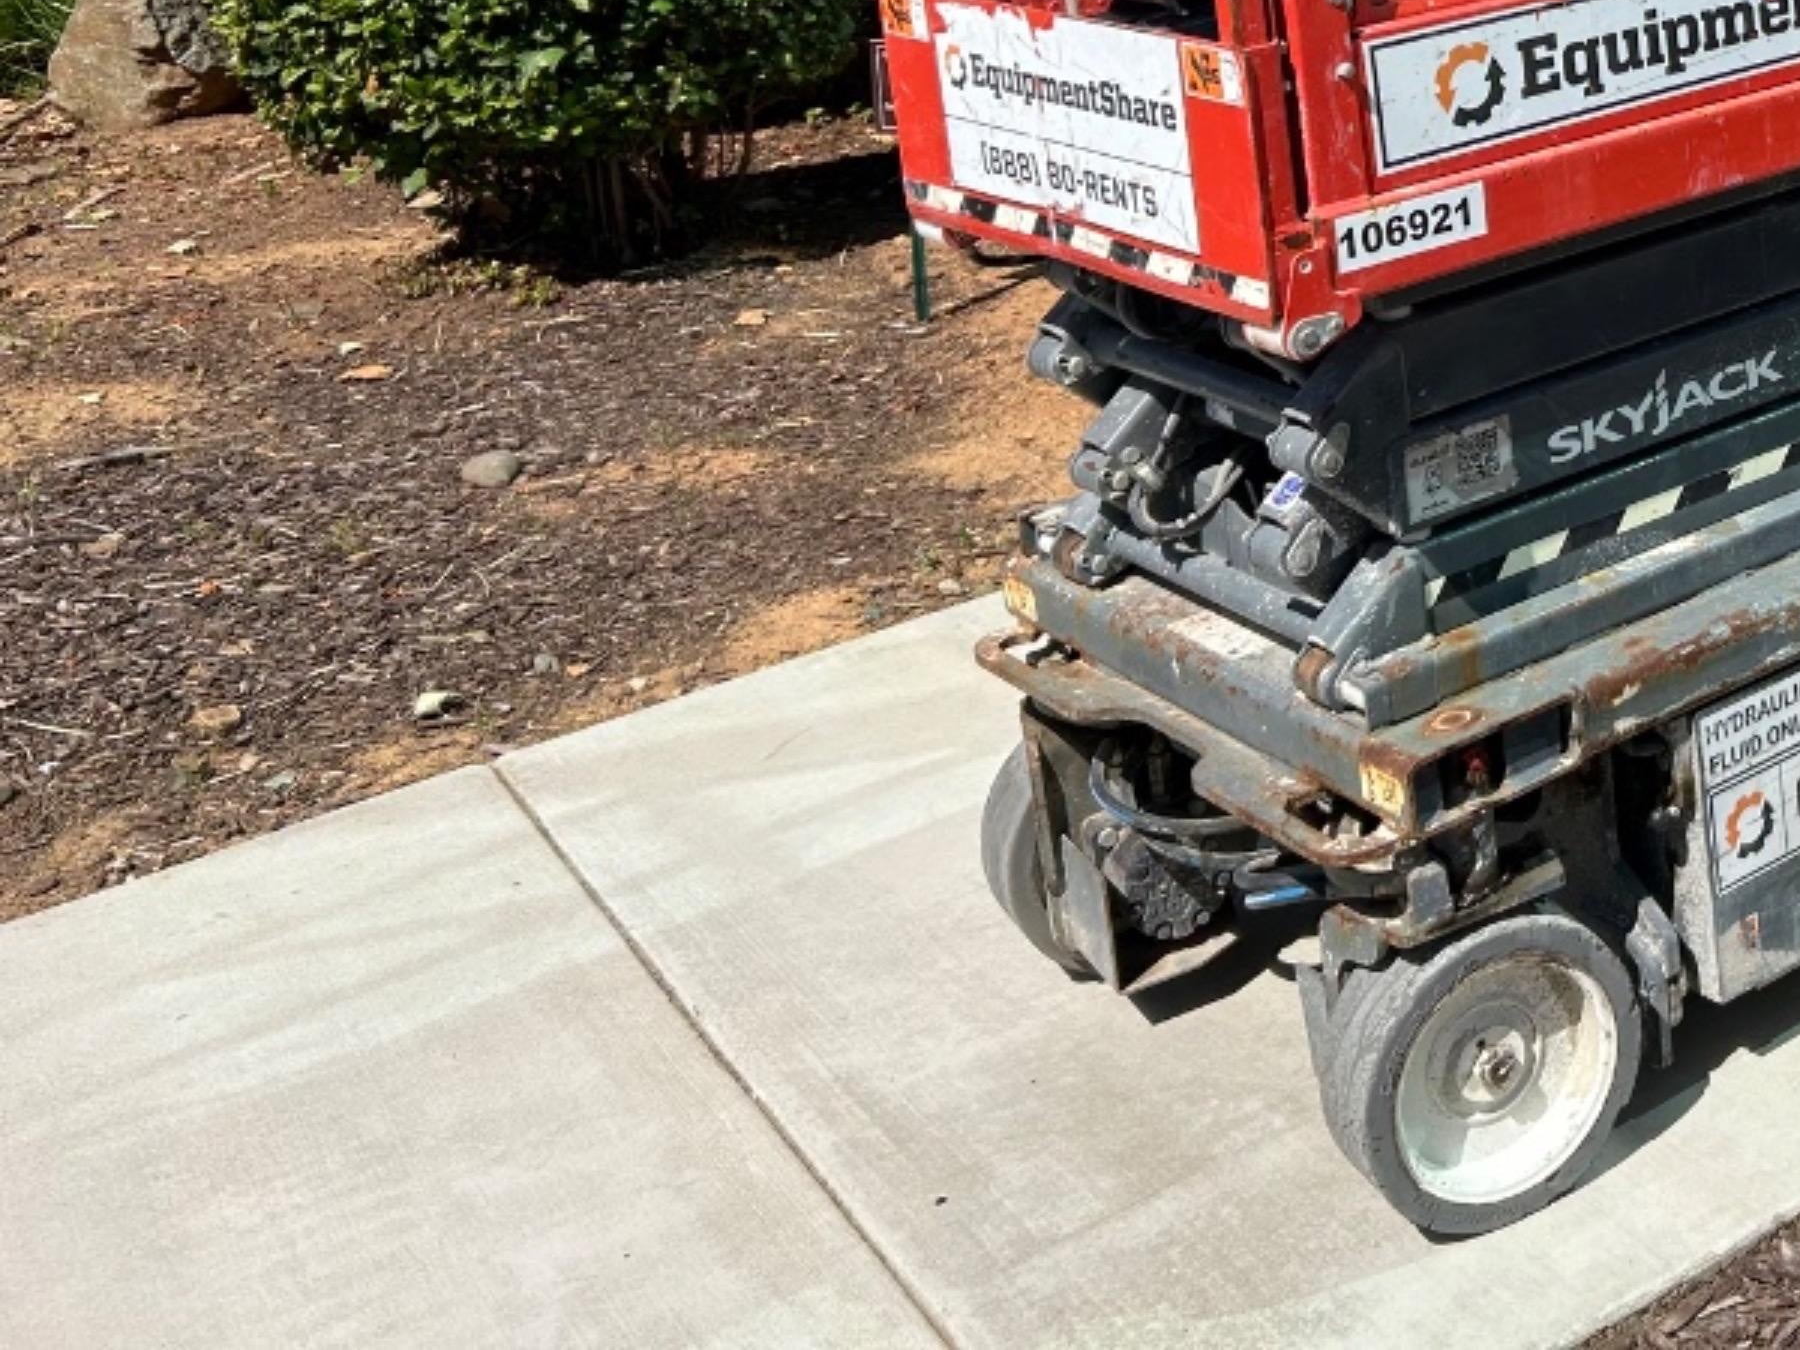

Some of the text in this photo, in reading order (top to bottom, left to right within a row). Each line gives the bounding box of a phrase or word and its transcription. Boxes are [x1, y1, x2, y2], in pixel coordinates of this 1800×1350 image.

[970, 52, 1178, 133] EquipmentShare
[979, 140, 1160, 219] (888) 80-RENTS
[1338, 196, 1472, 259] 106921
[1709, 733, 1762, 776] FLUID
